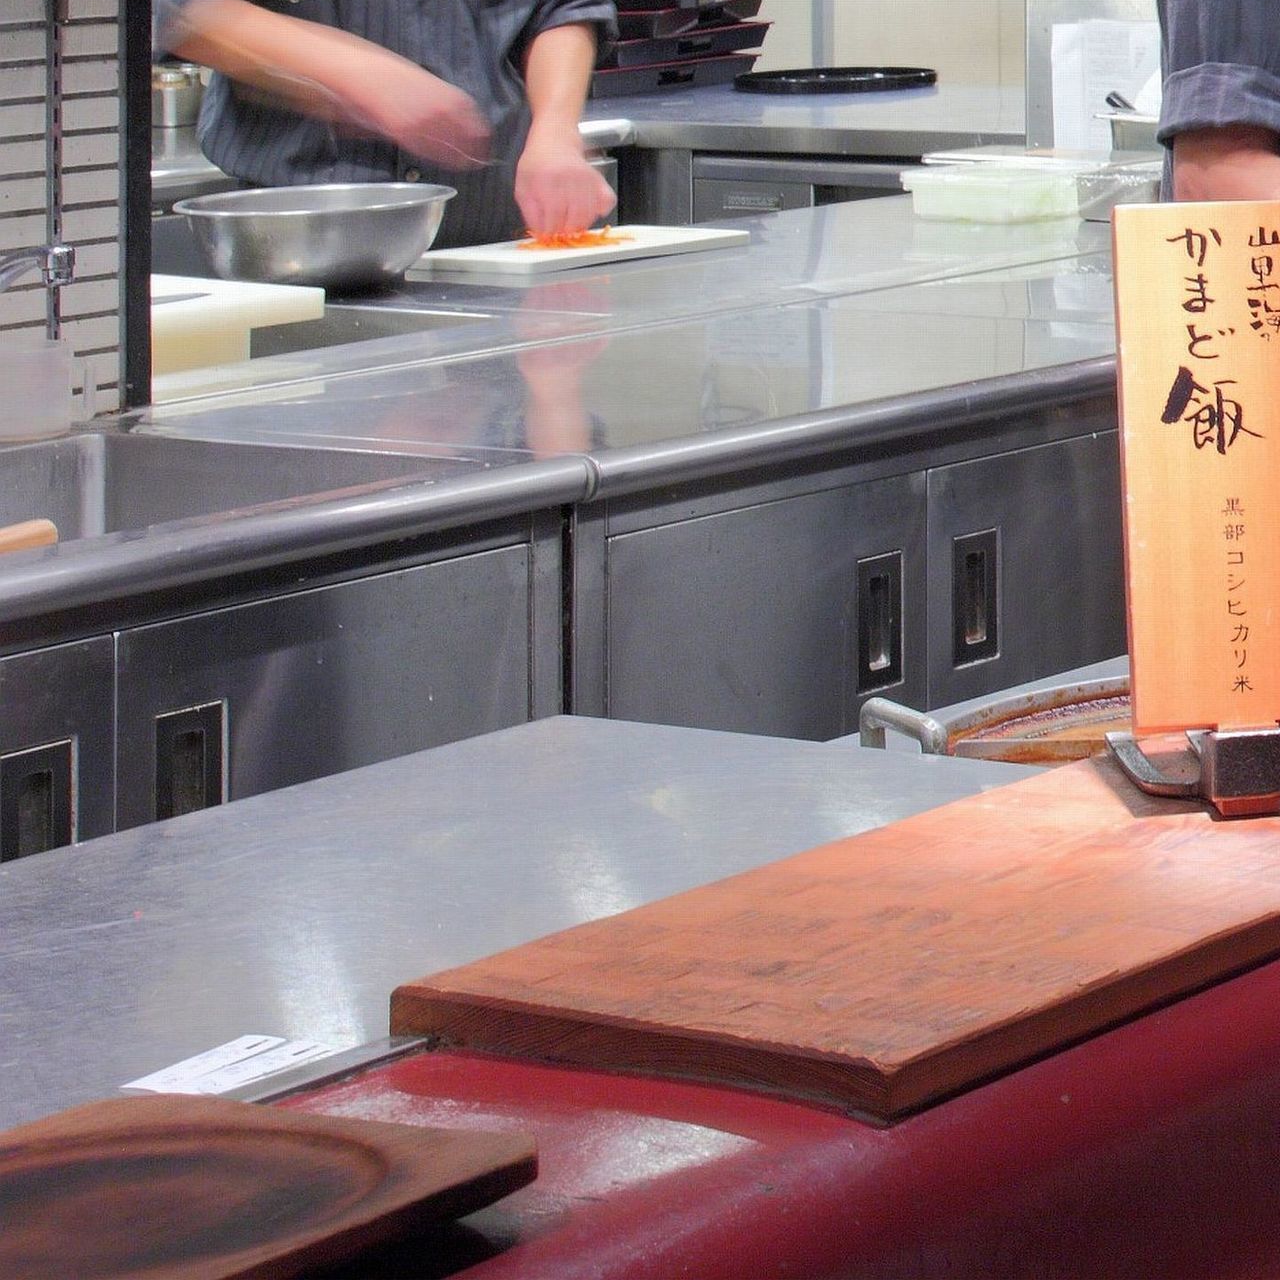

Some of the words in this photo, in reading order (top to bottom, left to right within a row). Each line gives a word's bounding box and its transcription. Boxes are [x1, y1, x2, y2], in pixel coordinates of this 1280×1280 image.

[1160, 227, 1266, 456] かまど飯
[1220, 497, 1254, 694] 黒部コシヒカリ米
